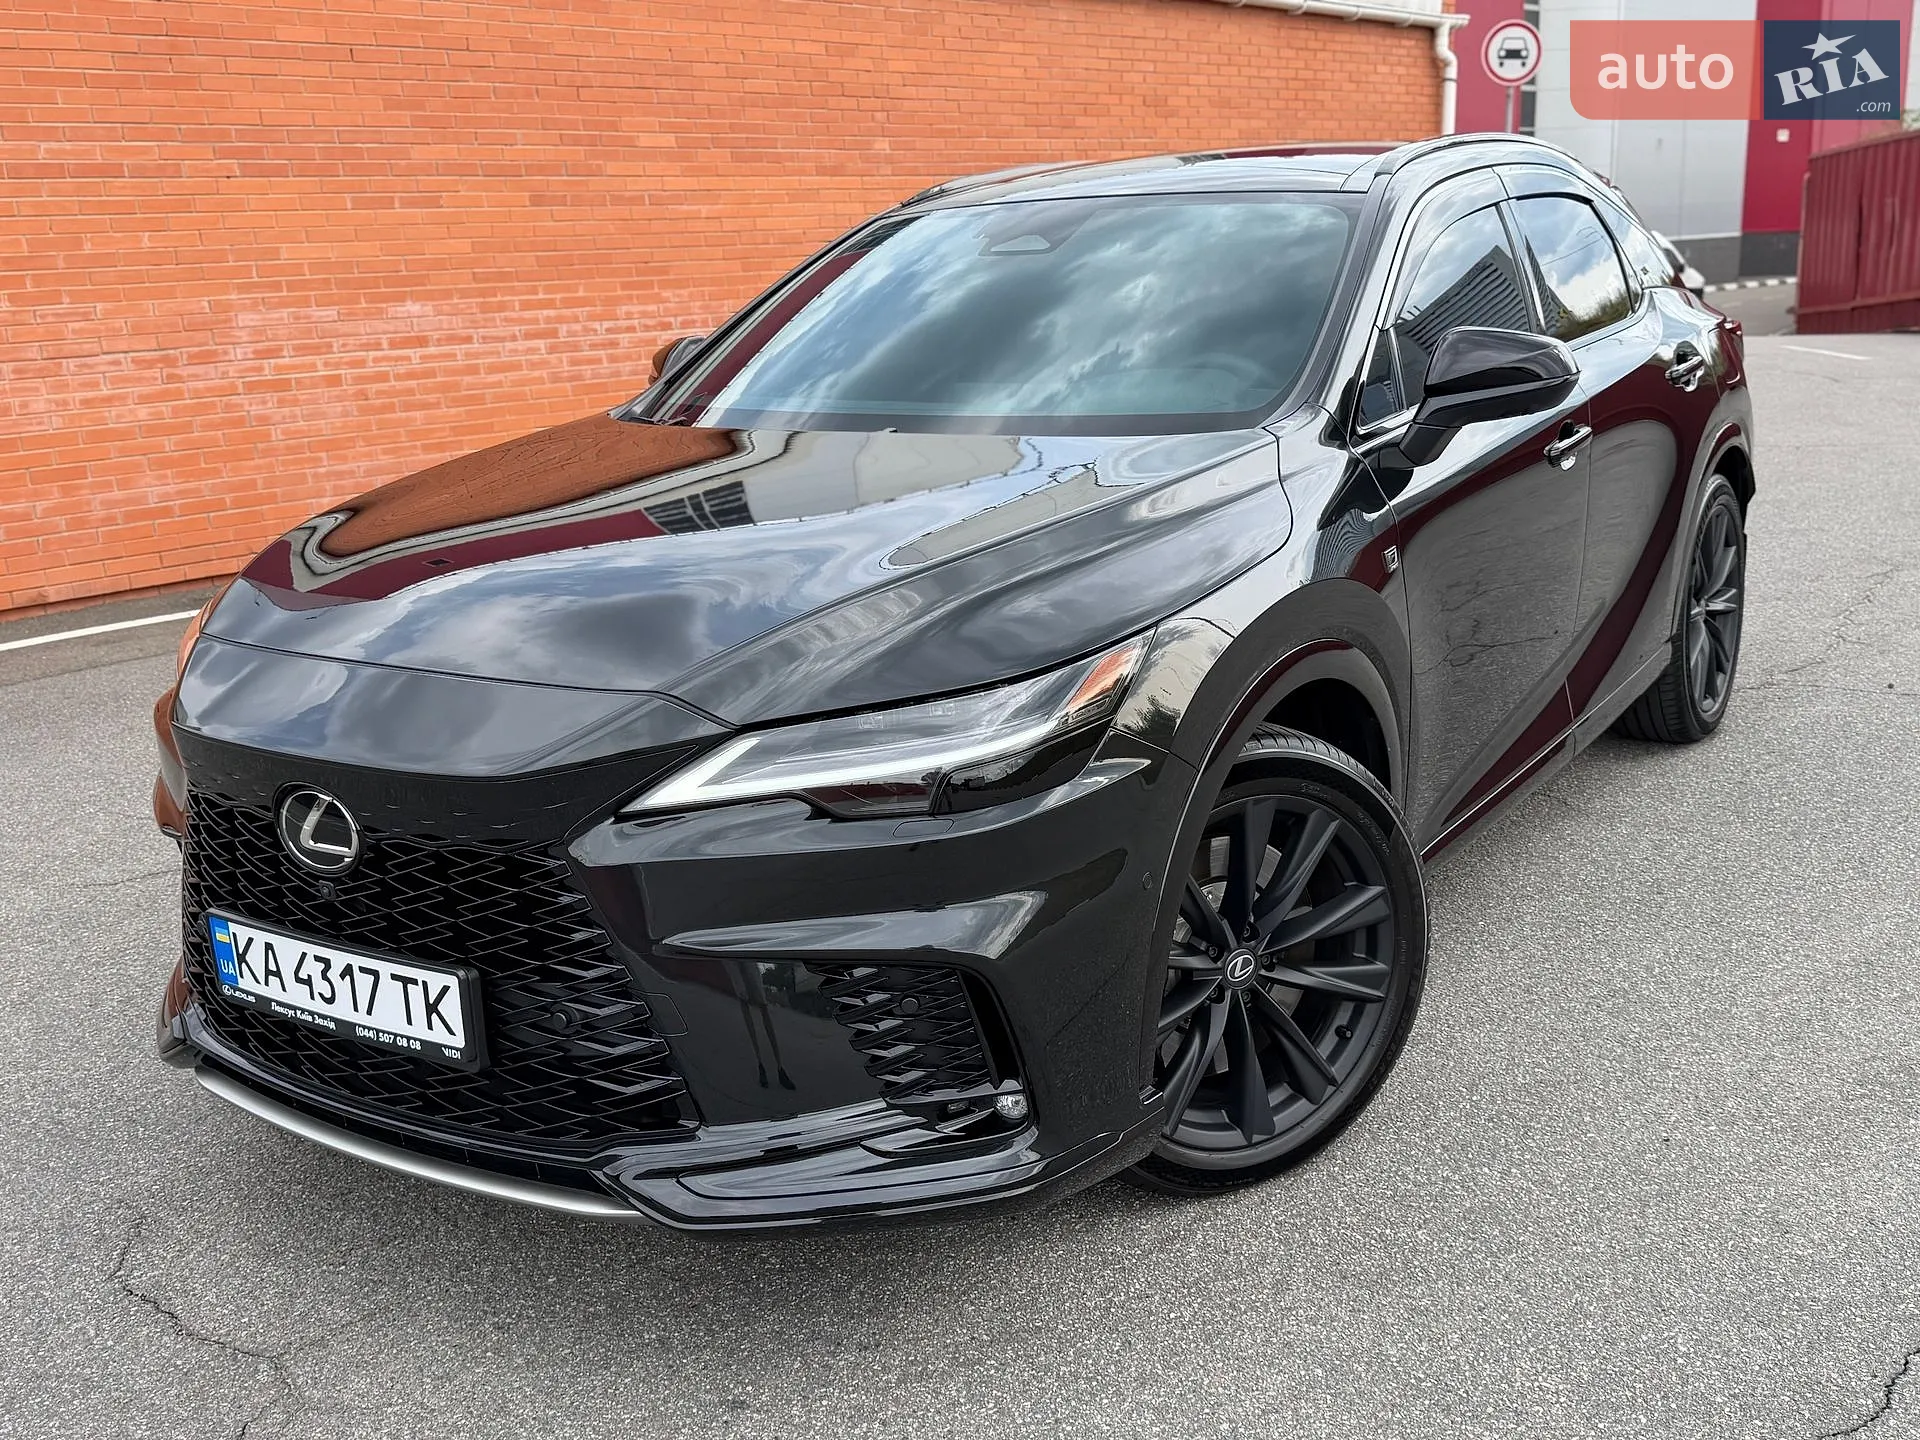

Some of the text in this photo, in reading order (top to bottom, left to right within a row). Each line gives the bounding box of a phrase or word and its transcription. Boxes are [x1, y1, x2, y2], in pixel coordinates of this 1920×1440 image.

[220, 958, 236, 977] UA
[232, 931, 457, 1037] KA 4317 TK
[313, 1014, 337, 1031] Захід
[355, 1025, 422, 1051] (044) 507 08 08
[441, 1046, 461, 1060] VIDI
